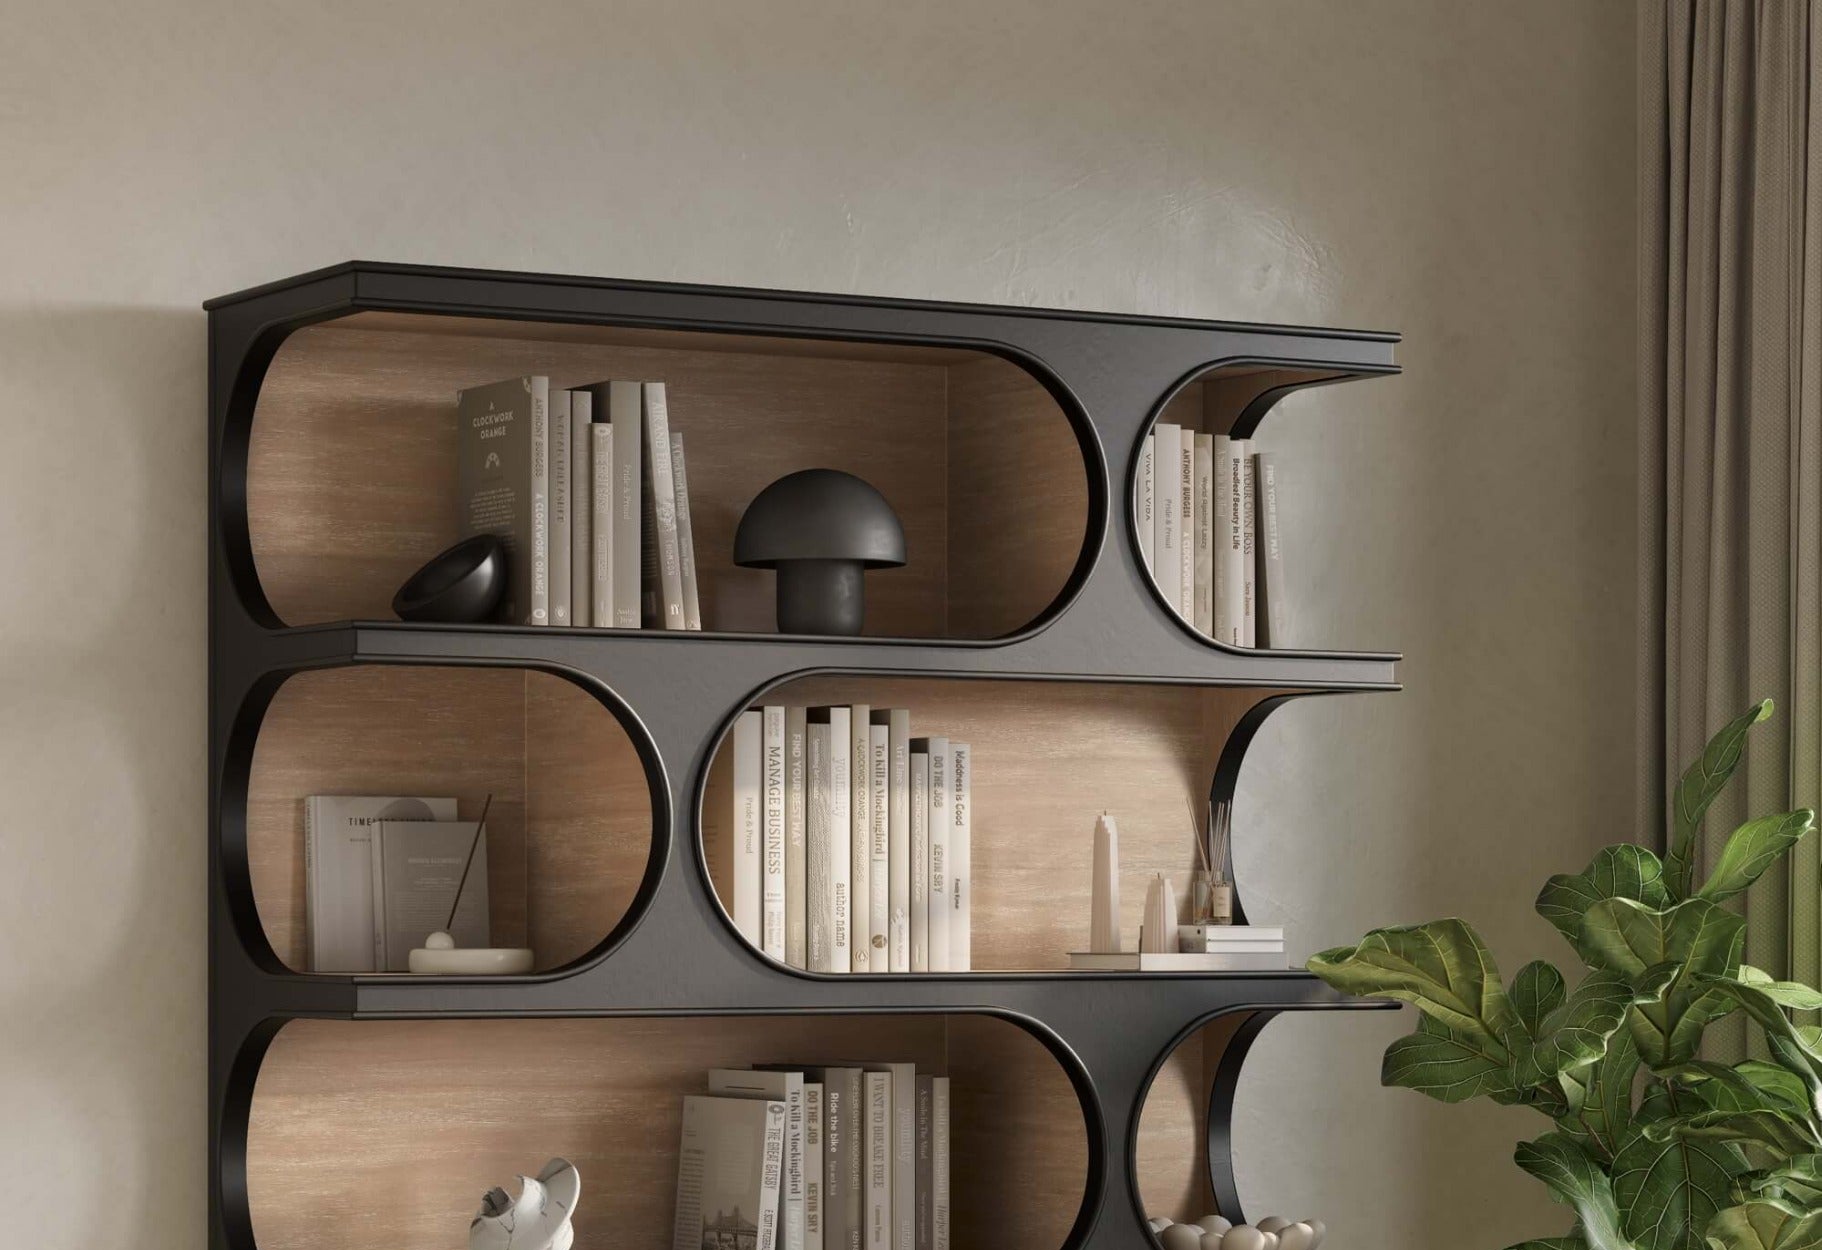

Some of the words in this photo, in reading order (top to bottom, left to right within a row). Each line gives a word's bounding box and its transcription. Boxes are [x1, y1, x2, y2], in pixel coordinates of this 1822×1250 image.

[489, 402, 495, 411] A
[473, 410, 514, 428] CLOCKWORK
[535, 398, 543, 439] ANTHONY
[481, 425, 506, 440] ORANGE
[535, 441, 543, 478] BURGESS
[1183, 448, 1191, 484] ANTHONY
[1244, 458, 1252, 471] BE
[1232, 457, 1240, 496] Broadleaf
[1244, 472, 1252, 499] YOUR
[1183, 486, 1191, 518] BURGESS
[1232, 497, 1240, 524] Beauty
[1244, 501, 1252, 528] OWN
[535, 503, 543, 553] CLOCKWORK
[1232, 535, 1240, 550] Life
[1244, 532, 1252, 555] BOSS
[535, 556, 543, 596] ORANGE
[791, 734, 801, 757] FIND
[873, 743, 885, 757] To
[873, 759, 885, 779] Kill
[933, 756, 943, 769] DO
[955, 750, 965, 793] Maddness
[767, 746, 781, 804] MANAGE
[791, 760, 801, 790] YOUR
[933, 770, 943, 788] THE
[791, 792, 801, 819] BEST
[933, 789, 943, 808] JOB
[873, 788, 885, 855] Mockingbird
[955, 804, 965, 827] Good
[767, 808, 781, 875] BUSINESS
[836, 882, 846, 917] author
[836, 920, 846, 947] name
[789, 1089, 801, 1103] To
[807, 1090, 818, 1102] DO
[830, 1092, 840, 1114] Ride
[872, 1083, 884, 1108] WANT
[789, 1105, 801, 1122] Kill
[807, 1106, 818, 1124] THE
[830, 1115, 840, 1131] the
[872, 1111, 884, 1123] TO
[767, 1127, 780, 1141] THE
[807, 1126, 818, 1145] JOB
[830, 1132, 840, 1153] bike
[766, 1141, 780, 1163] GREAT
[789, 1132, 801, 1194] Mockingbird
[764, 1163, 779, 1190] GATSBY
[872, 1164, 884, 1189] FREE
[807, 1183, 818, 1212] KEVIN
